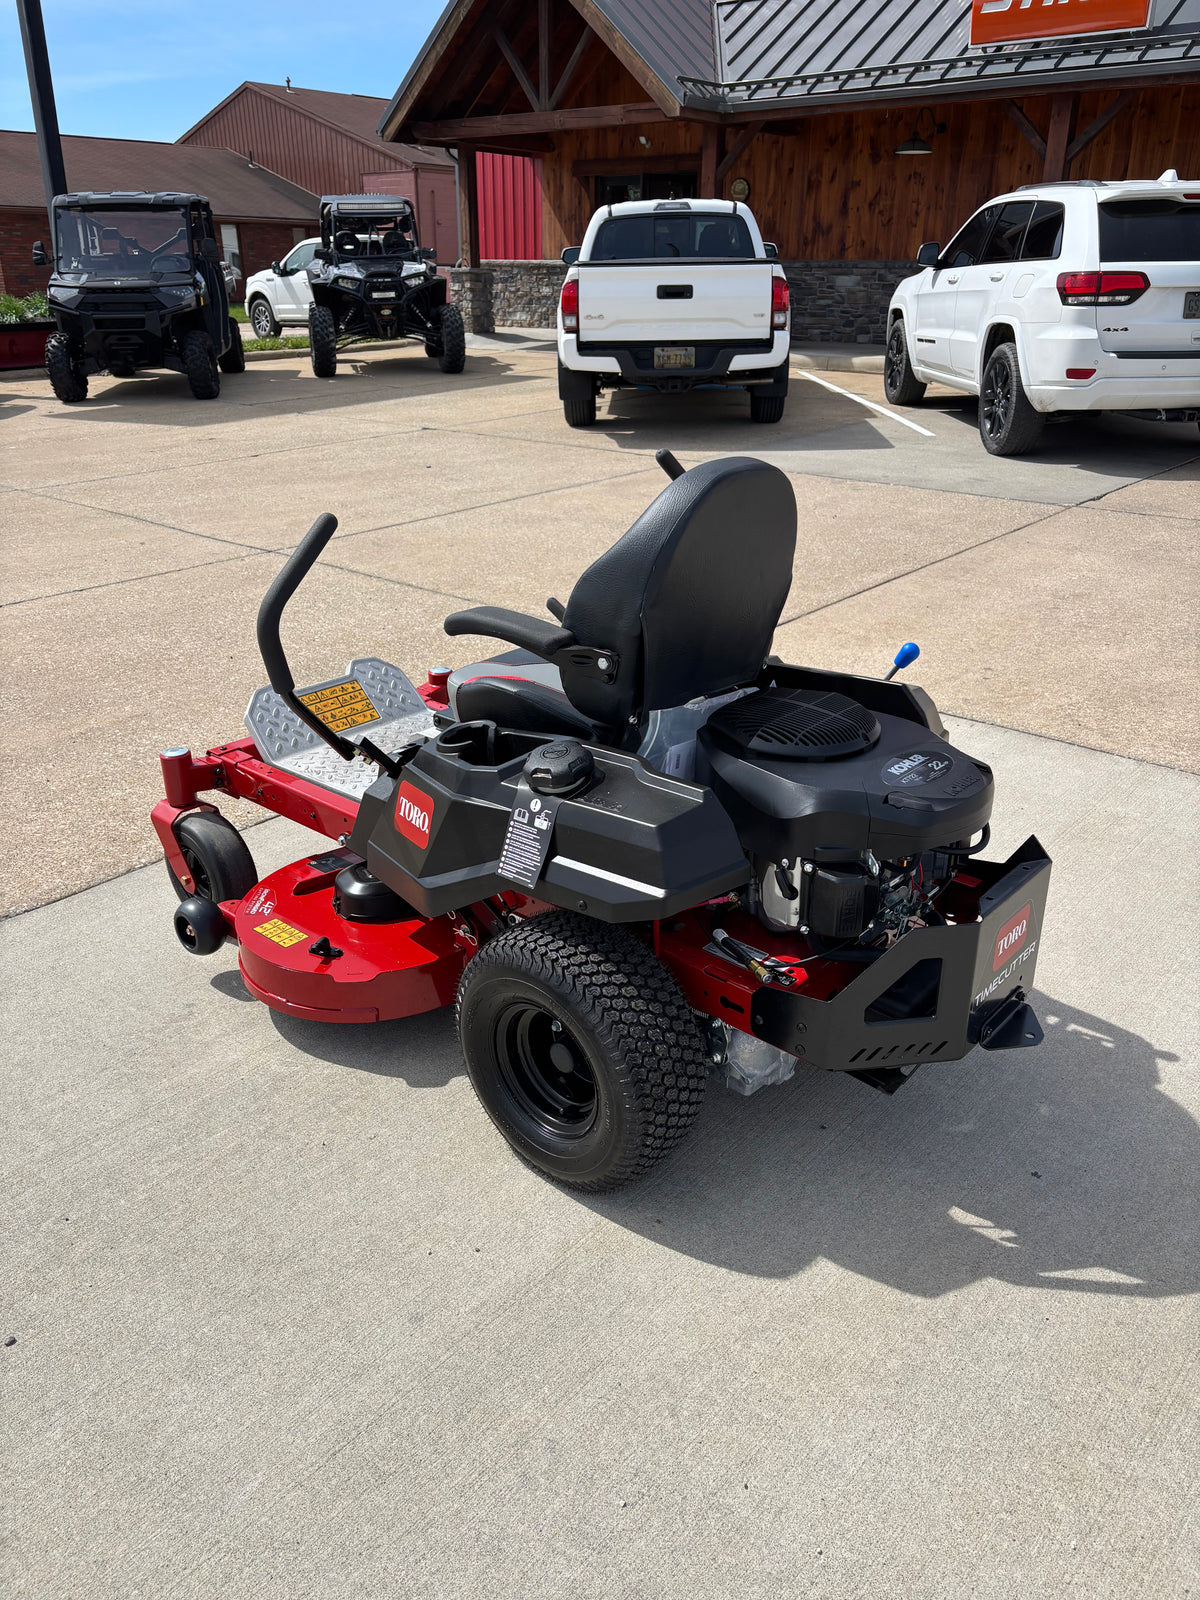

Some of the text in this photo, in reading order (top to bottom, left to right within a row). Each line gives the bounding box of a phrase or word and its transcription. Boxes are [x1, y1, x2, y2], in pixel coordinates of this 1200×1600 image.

[887, 754, 930, 775] KOHLER
[928, 760, 945, 770] 22
[399, 796, 429, 834] TORO
[997, 919, 1027, 957] TORO
[974, 941, 1037, 1007] TIMECUTTER
